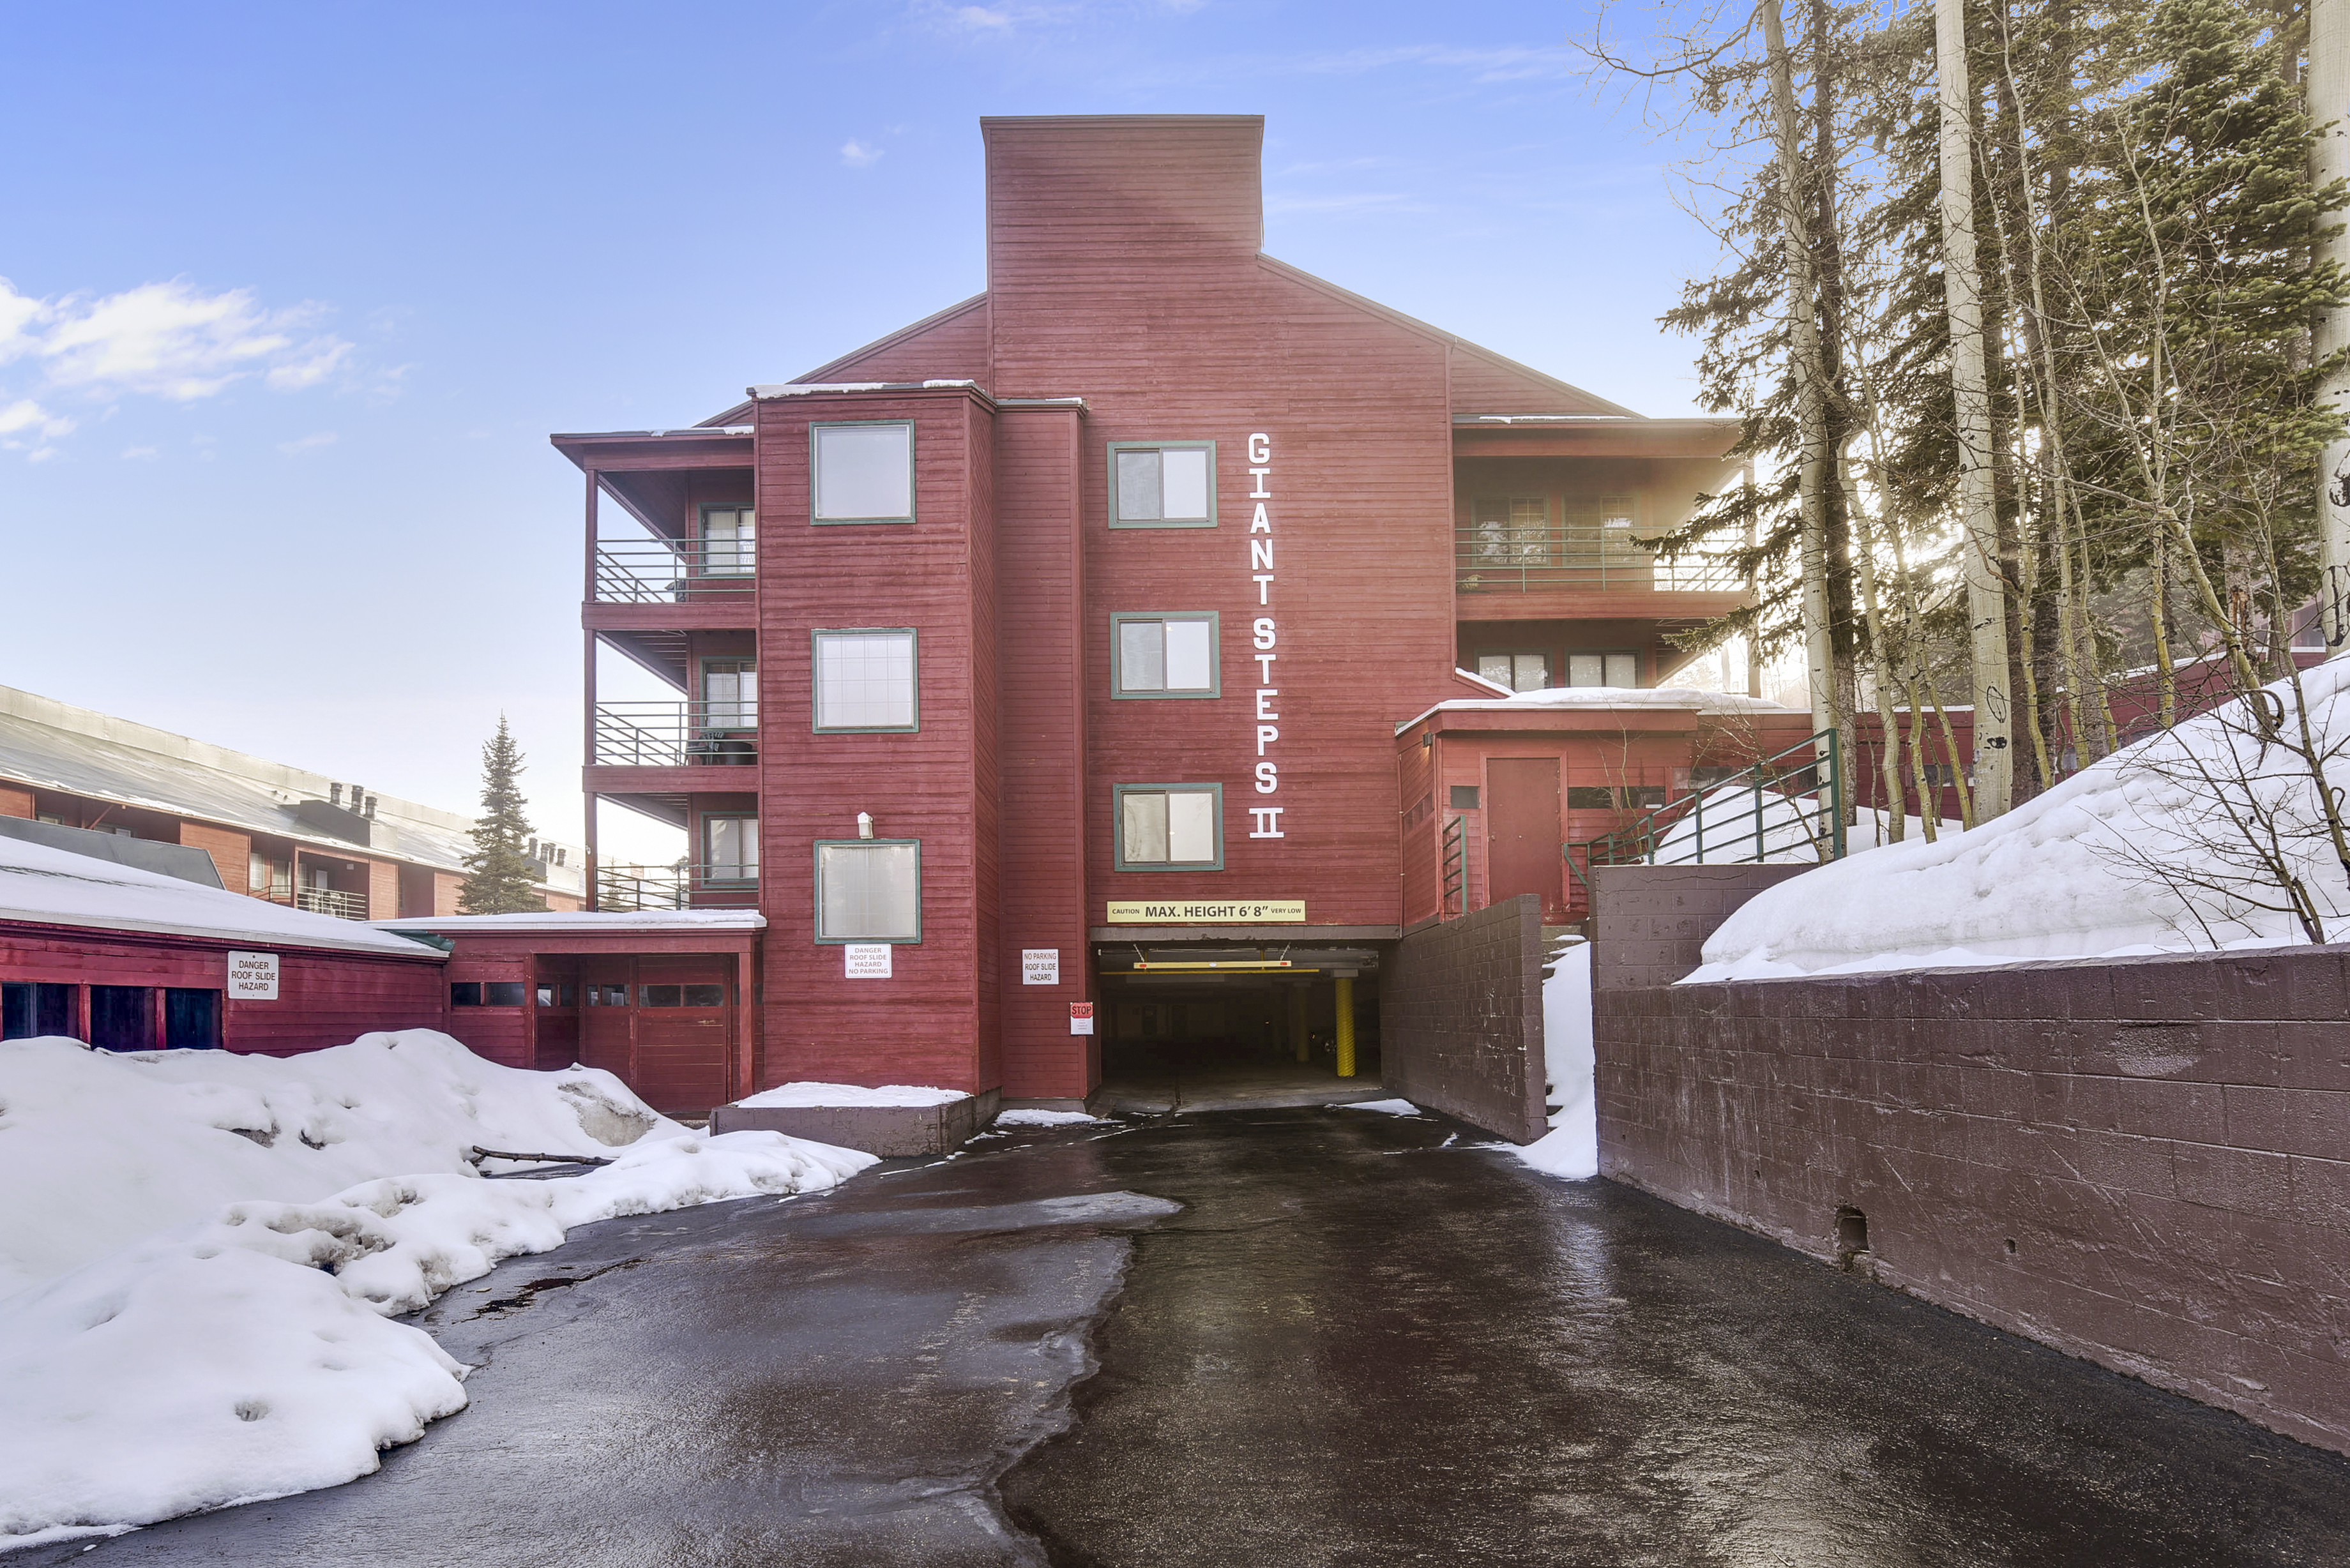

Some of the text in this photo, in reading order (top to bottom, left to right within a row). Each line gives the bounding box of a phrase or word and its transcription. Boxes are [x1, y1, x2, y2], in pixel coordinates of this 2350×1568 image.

[1248, 432, 1285, 838] GIANT STEPS II
[1145, 906, 1181, 917] MAX.
[1184, 906, 1236, 917] HEIGHT
[239, 960, 269, 970] DANGER
[231, 970, 276, 981] ROOF SLIDE
[239, 982, 269, 991] HAZARD
[1072, 1006, 1091, 1014] STOP
